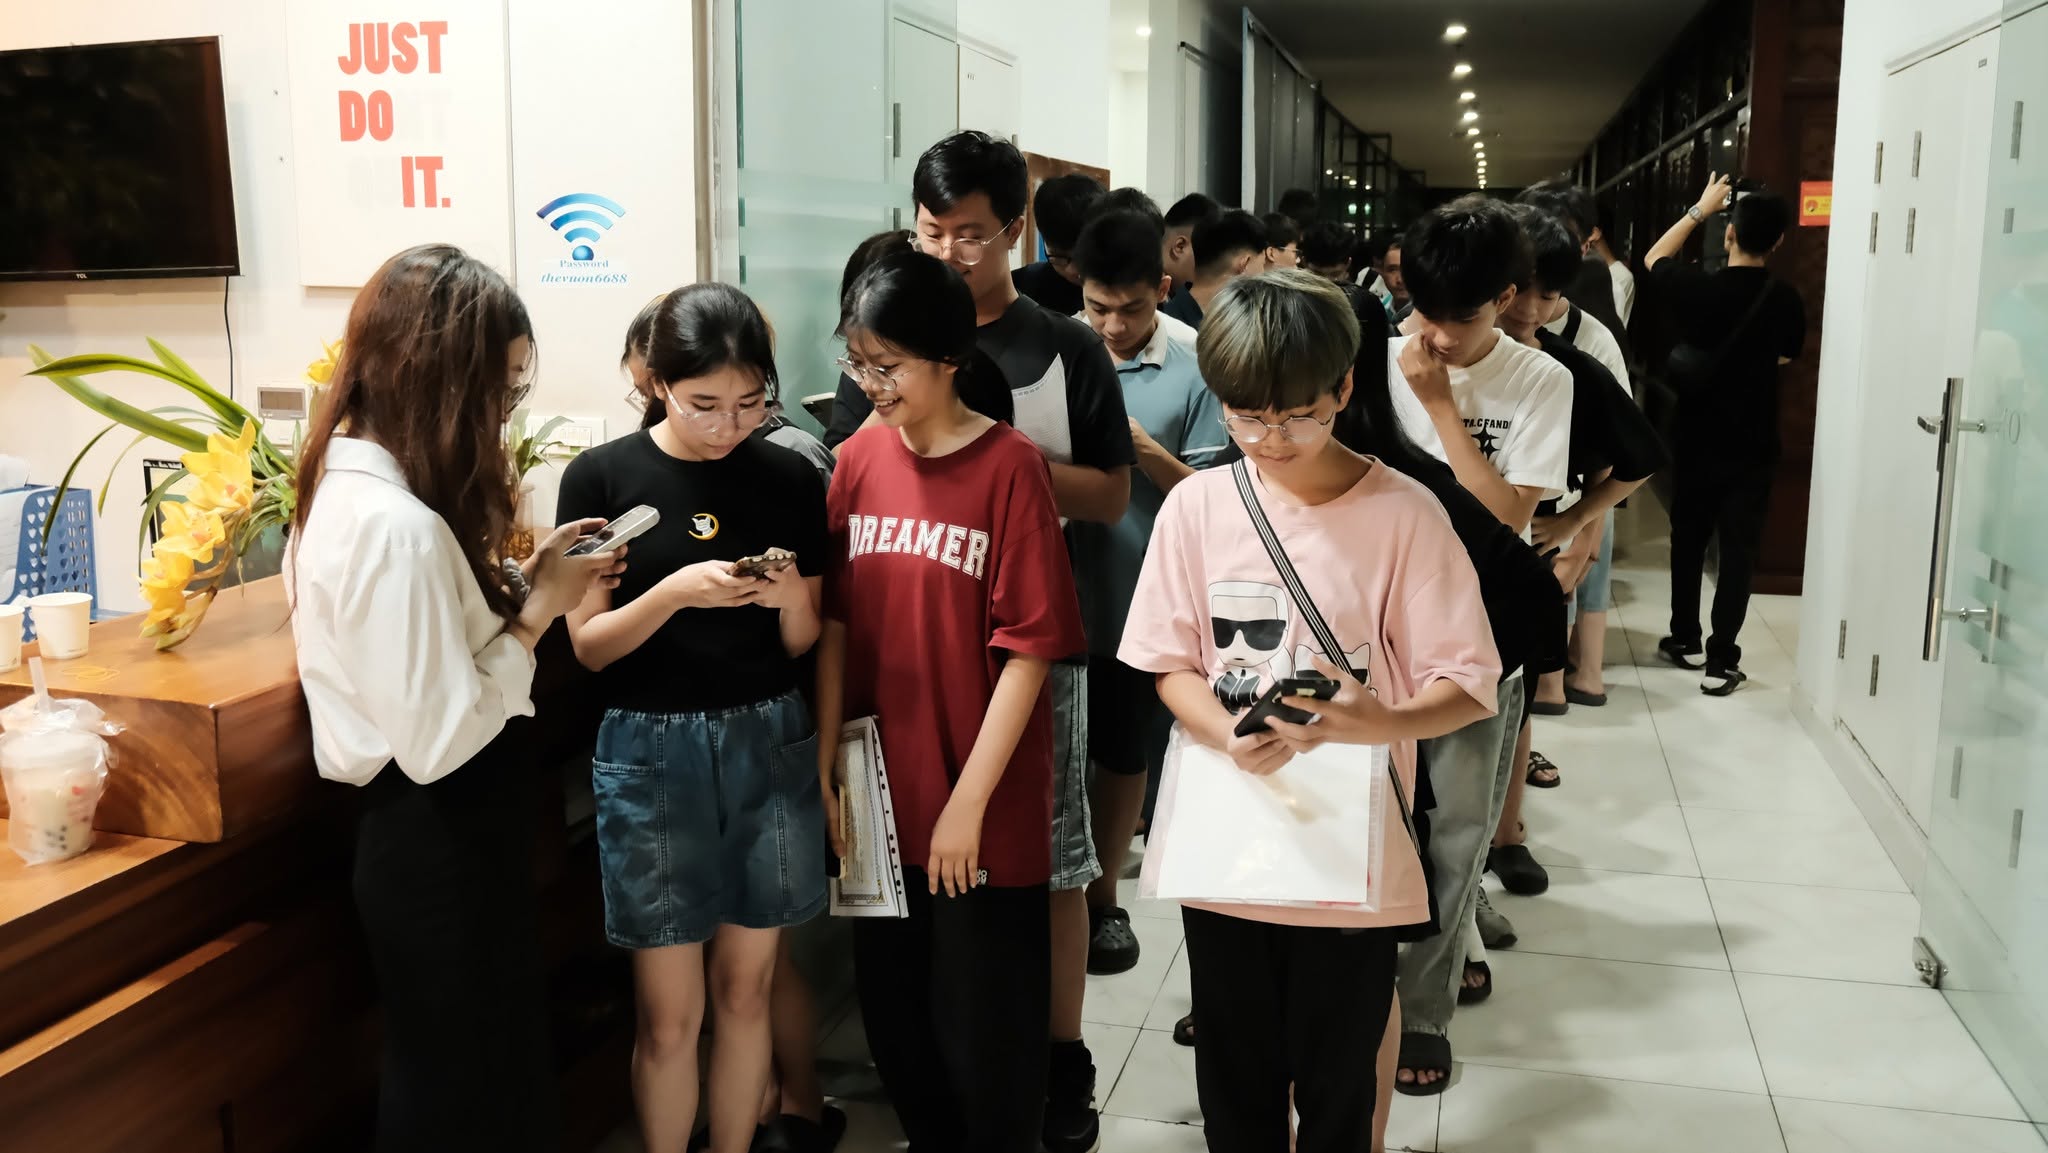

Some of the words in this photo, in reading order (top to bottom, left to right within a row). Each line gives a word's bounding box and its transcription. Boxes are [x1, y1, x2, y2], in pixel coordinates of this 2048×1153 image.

[337, 20, 449, 75] JUST
[338, 89, 394, 143] DO
[541, 273, 627, 283] thevuon6688
[560, 260, 608, 268] Password
[848, 514, 989, 581] DREAMER
